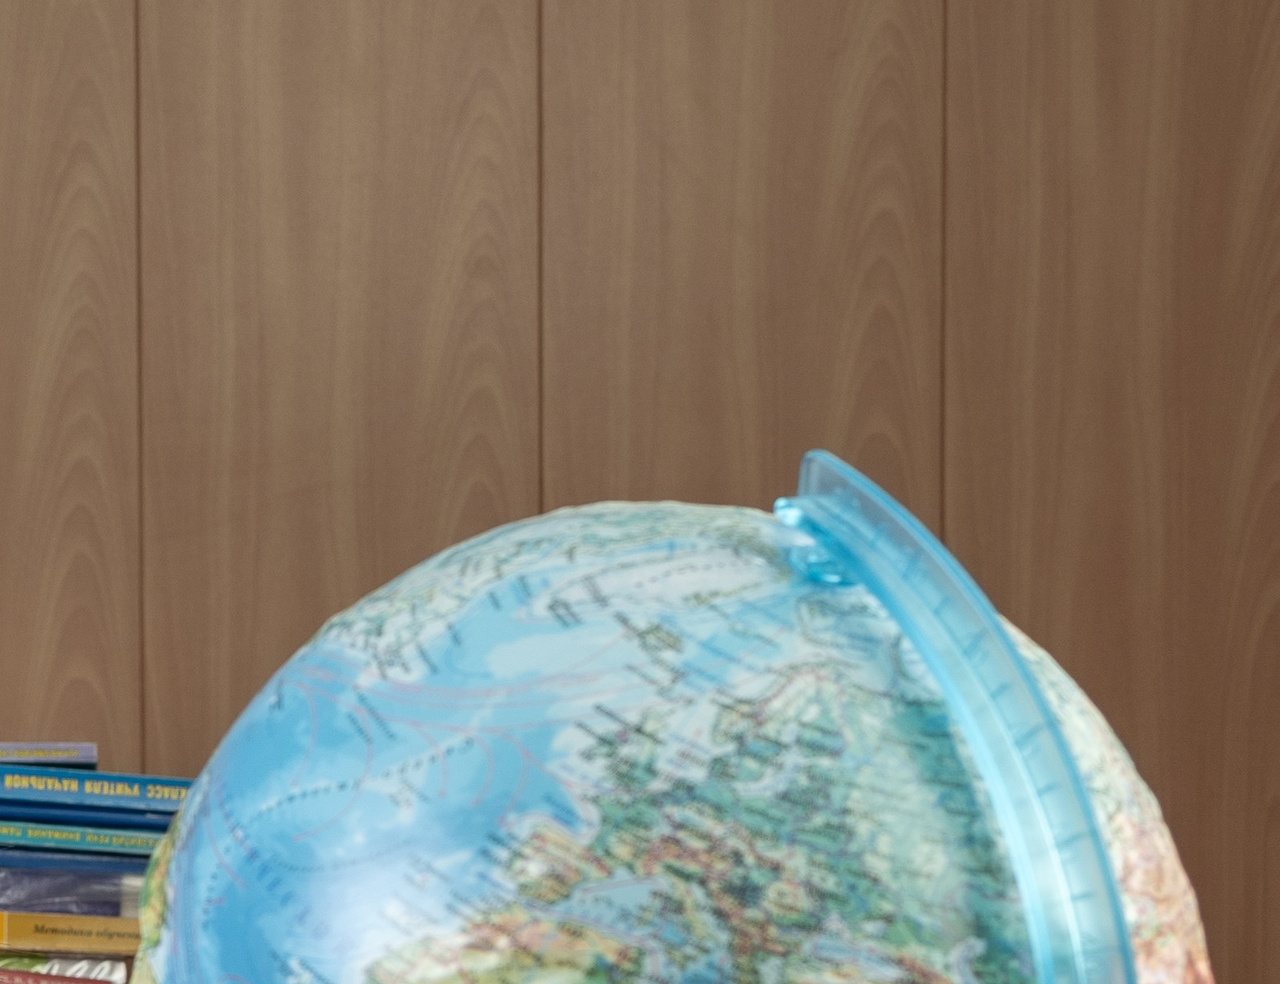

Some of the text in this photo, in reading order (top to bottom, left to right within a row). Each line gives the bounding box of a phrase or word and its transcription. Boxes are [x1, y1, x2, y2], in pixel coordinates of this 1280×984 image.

[5, 772, 79, 792] НАЧАЛЬНОЙ
[84, 779, 141, 797] УЧИТЕЛЯ
[33, 923, 93, 938] Методика
